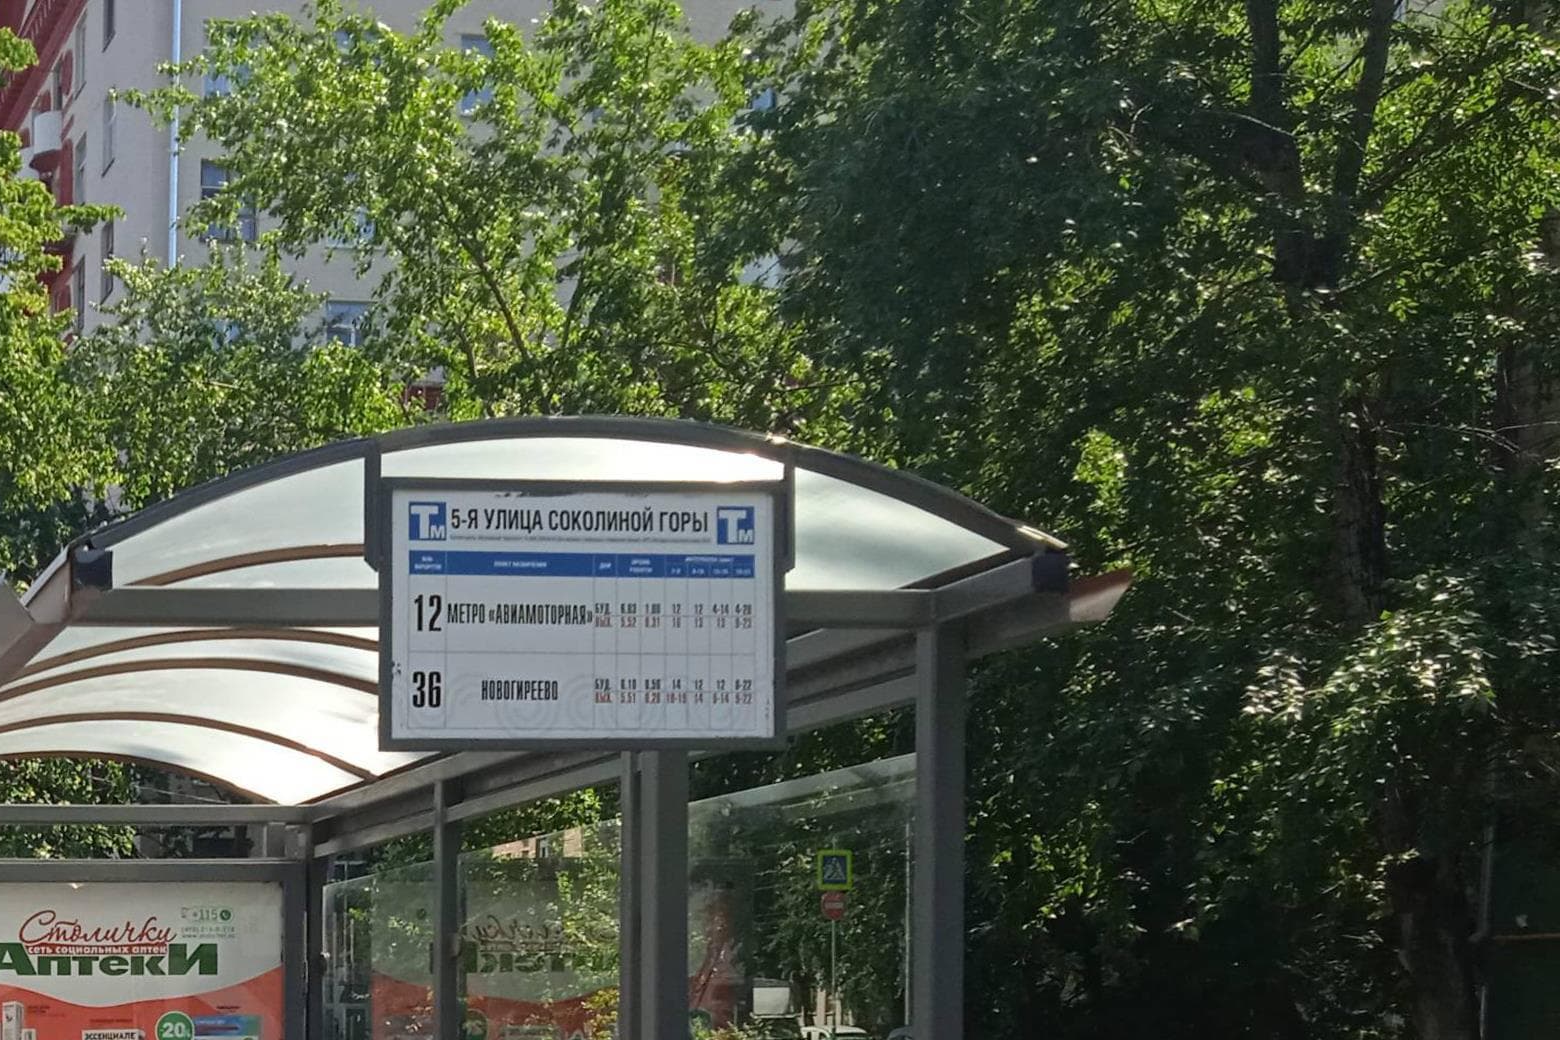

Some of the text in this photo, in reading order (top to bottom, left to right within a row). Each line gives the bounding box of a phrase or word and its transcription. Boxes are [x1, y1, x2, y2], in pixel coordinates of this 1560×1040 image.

[451, 506, 709, 533] 5-Я УЛИЦА СОКОЛИНОЙ ГОРЫ
[414, 594, 442, 631] 12
[447, 603, 593, 625] МЕТРО «АВИАМОТОРНАЯ»
[412, 671, 442, 708] 36
[481, 680, 558, 700] НОВОГИРЕЕВО
[19, 910, 177, 943] Столички
[28, 946, 167, 955] сеть социальных аптек
